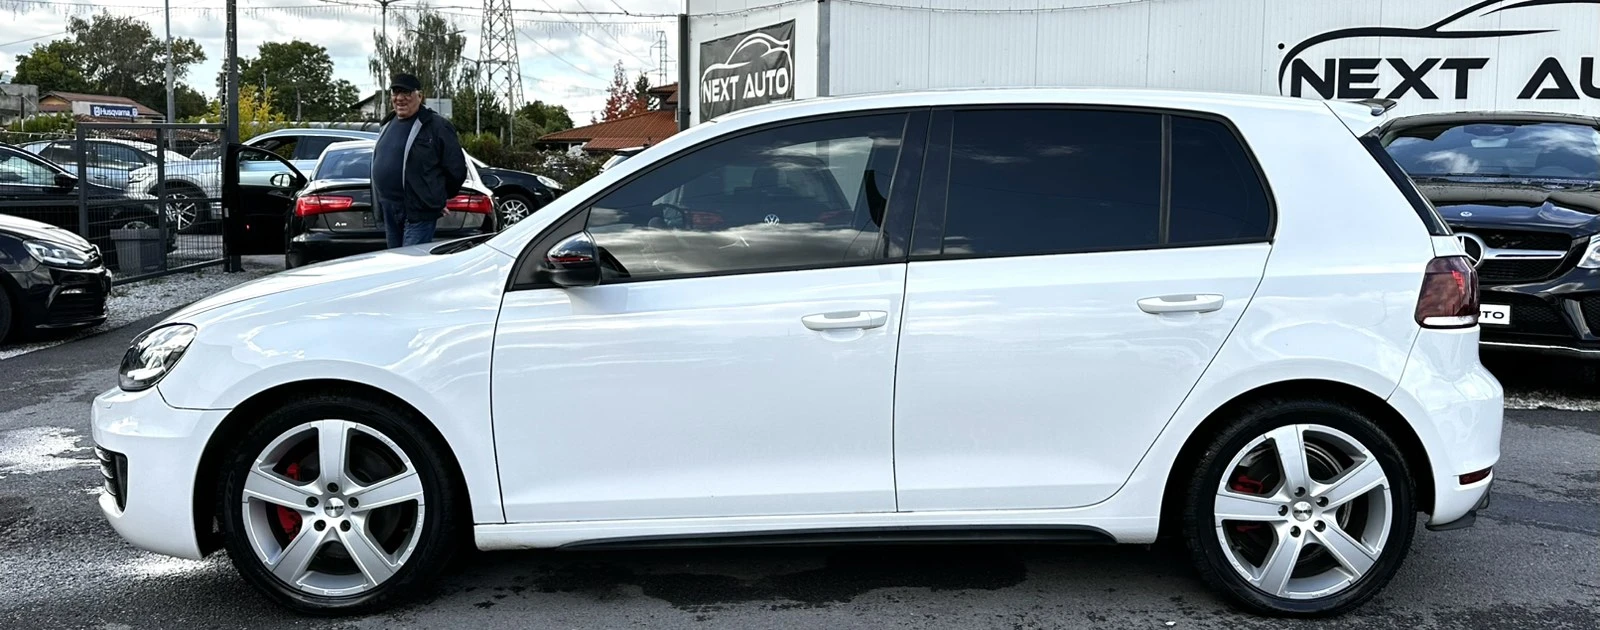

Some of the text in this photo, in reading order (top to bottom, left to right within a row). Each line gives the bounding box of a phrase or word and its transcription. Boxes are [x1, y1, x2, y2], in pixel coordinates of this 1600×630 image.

[703, 67, 789, 103] NEXT AUTO
[1290, 58, 1490, 99] NEXT
[101, 107, 130, 117] Husqvarna
